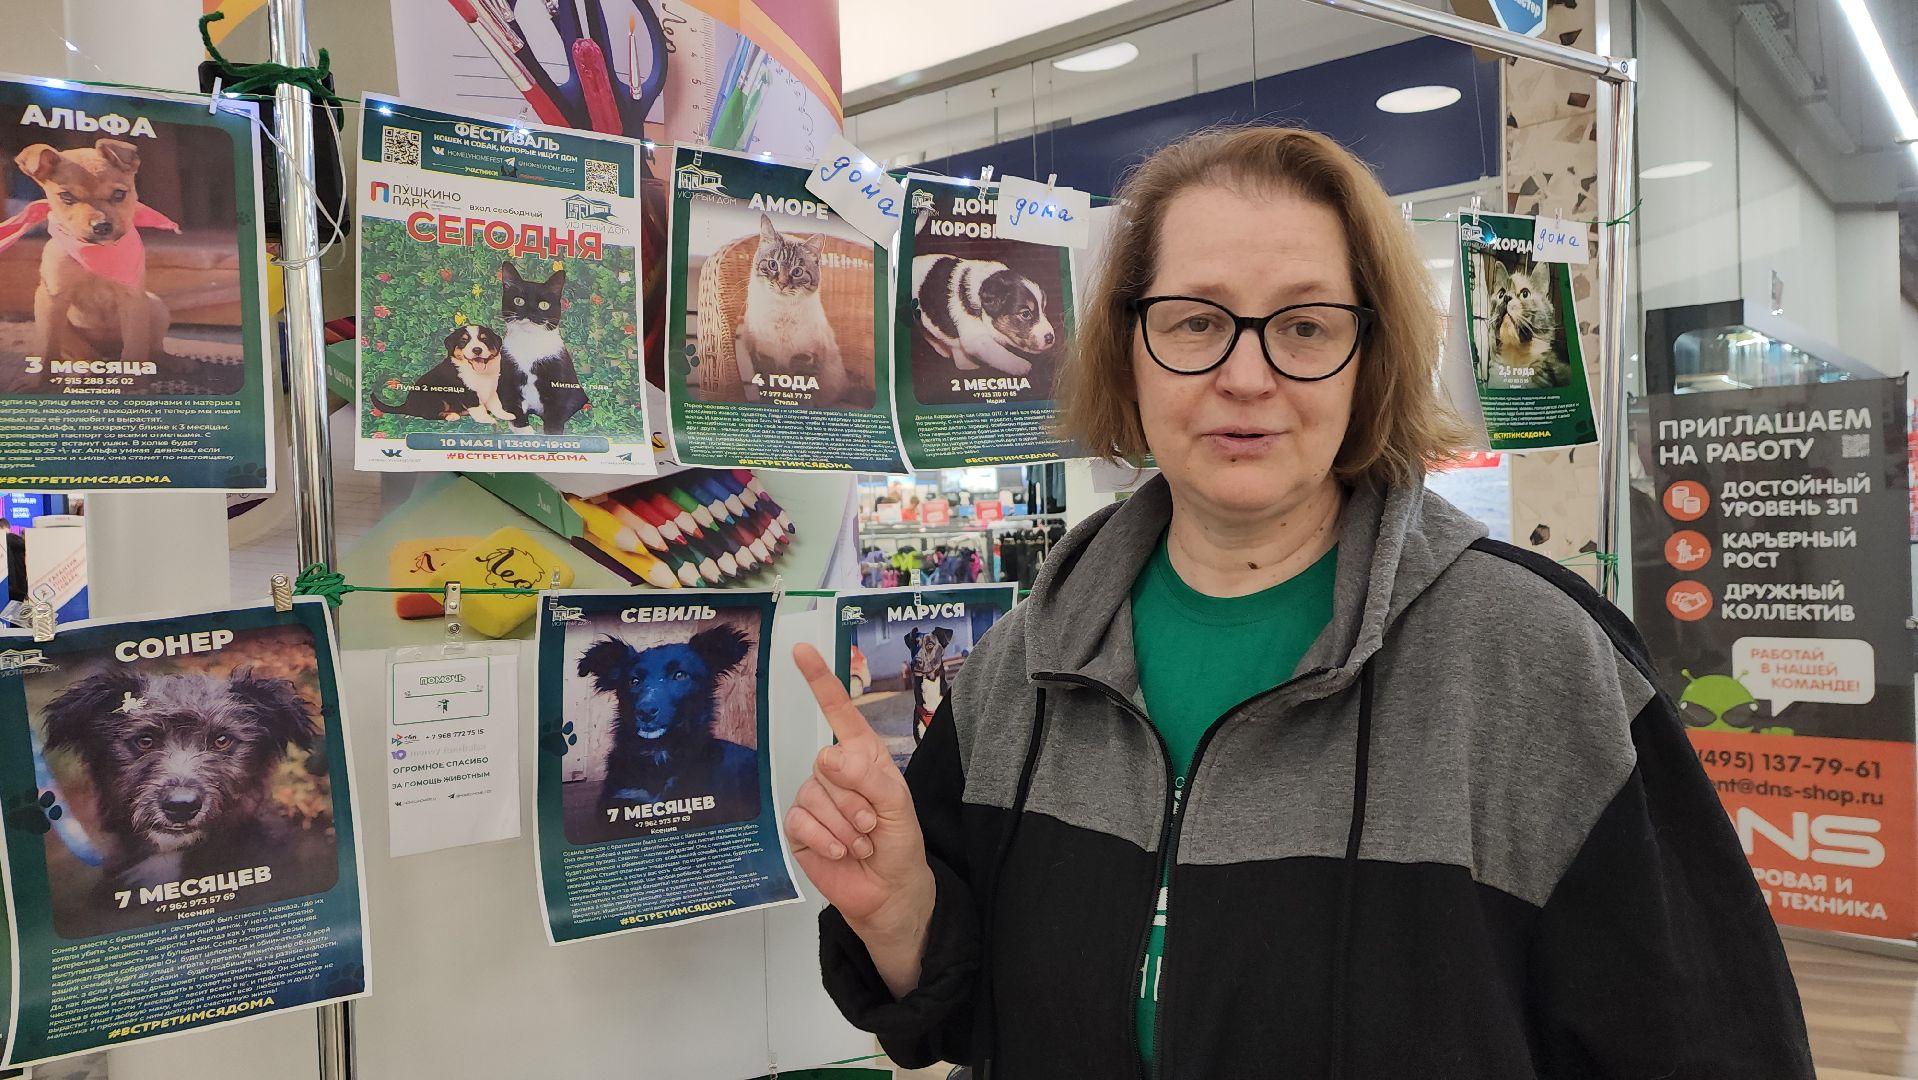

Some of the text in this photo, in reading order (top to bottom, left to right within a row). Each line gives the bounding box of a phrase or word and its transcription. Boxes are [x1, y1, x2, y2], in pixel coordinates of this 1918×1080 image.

[20, 104, 157, 138] АЛЬФА
[455, 123, 560, 151] ФЕСТИВАЛЬ
[433, 134, 462, 145] КОШЕК
[471, 140, 499, 152] СОБАК,
[500, 145, 536, 156] КОТОРЫЕ
[538, 150, 559, 160] ИЩУТ
[561, 153, 578, 163] ДОМ
[393, 184, 462, 202] ПУШКИНО
[820, 156, 899, 218] дома
[393, 196, 429, 209] ПАРК
[716, 195, 737, 206] ДОМ
[748, 192, 829, 220] АМОРЕ
[469, 205, 543, 218] вход свободный
[1010, 198, 1074, 226] дома
[407, 211, 603, 261] СЕГОДНЯ
[607, 226, 630, 235] ДОМ
[1537, 228, 1579, 252] дома
[24, 357, 157, 377] 3 месяца
[1498, 366, 1535, 377] 2,5 года
[49, 377, 135, 385] +7 915 288 56 02
[63, 386, 121, 395] Анастасия
[396, 384, 465, 394] Луна 2 месяца
[751, 373, 820, 391] 4 ГОДА
[951, 377, 1032, 392] 2 МЕСЯЦА
[1659, 407, 1872, 441] ПРИГЛАШАЕМ
[440, 438, 581, 450] 10 МАЯ 13:00-19:00
[1659, 438, 1815, 466] НА РАБОТУ
[447, 452, 588, 462] #ВСТРЕТИМСЯДОМА
[738, 459, 853, 470] #ВСТРЕТИМСЯДОМА
[965, 452, 1059, 464] #ВСТРЕТИМСЯДОМА
[0, 475, 171, 485] #ВСТРЕТИМСЯДОМА
[1720, 472, 1871, 500] ДОСТОЙНЫЙ
[1720, 498, 1858, 518] УРОВЕНЬ ЗП
[1722, 527, 1857, 549] КАРЬЕРНЫЙ
[1722, 552, 1780, 569] РОСТ
[1723, 580, 1845, 602] ДРУЖНЫЙ
[620, 605, 717, 624] СЕВИЛЬ
[887, 602, 965, 622] МАРУСЯ
[1721, 603, 1856, 623] КОЛЛЕКТИВ
[115, 629, 234, 663] СОНЕР
[1750, 647, 1825, 662] РАБОТАЙ
[1760, 663, 1838, 677] В НАШЕЙ
[419, 675, 465, 685] ПОМОЧЬ
[1771, 677, 1860, 692] КОМАНДЕ!
[437, 731, 451, 739] 968
[452, 730, 465, 738] 772
[466, 728, 475, 736] 75
[392, 758, 489, 774] ОГРОМНОЕ СПАСИБО
[1698, 749, 1881, 780] (495) 137-79-61
[391, 772, 490, 790] ЗА ПОМОЩЬ ЖИВОТНЫМ
[1714, 778, 1884, 807] nt@dns-shop.ru
[607, 795, 716, 823] 7 МЕСЯЦЕВ
[650, 826, 678, 835] Ксения
[1736, 806, 1886, 869] NS
[114, 865, 272, 909] 7 МЕСЯЦЕВ
[1751, 867, 1853, 895] РОВАЯ И
[155, 892, 236, 913] +7 962 973 57 69
[1778, 891, 1888, 921] ТЕХНИКА
[177, 907, 215, 920] Ксения
[620, 899, 737, 926] #ВСТРЕТИМСЯДОМА
[146, 933, 177, 946] добрый
[107, 996, 275, 1040] #ВСТРЕТИМСЯДОМА
